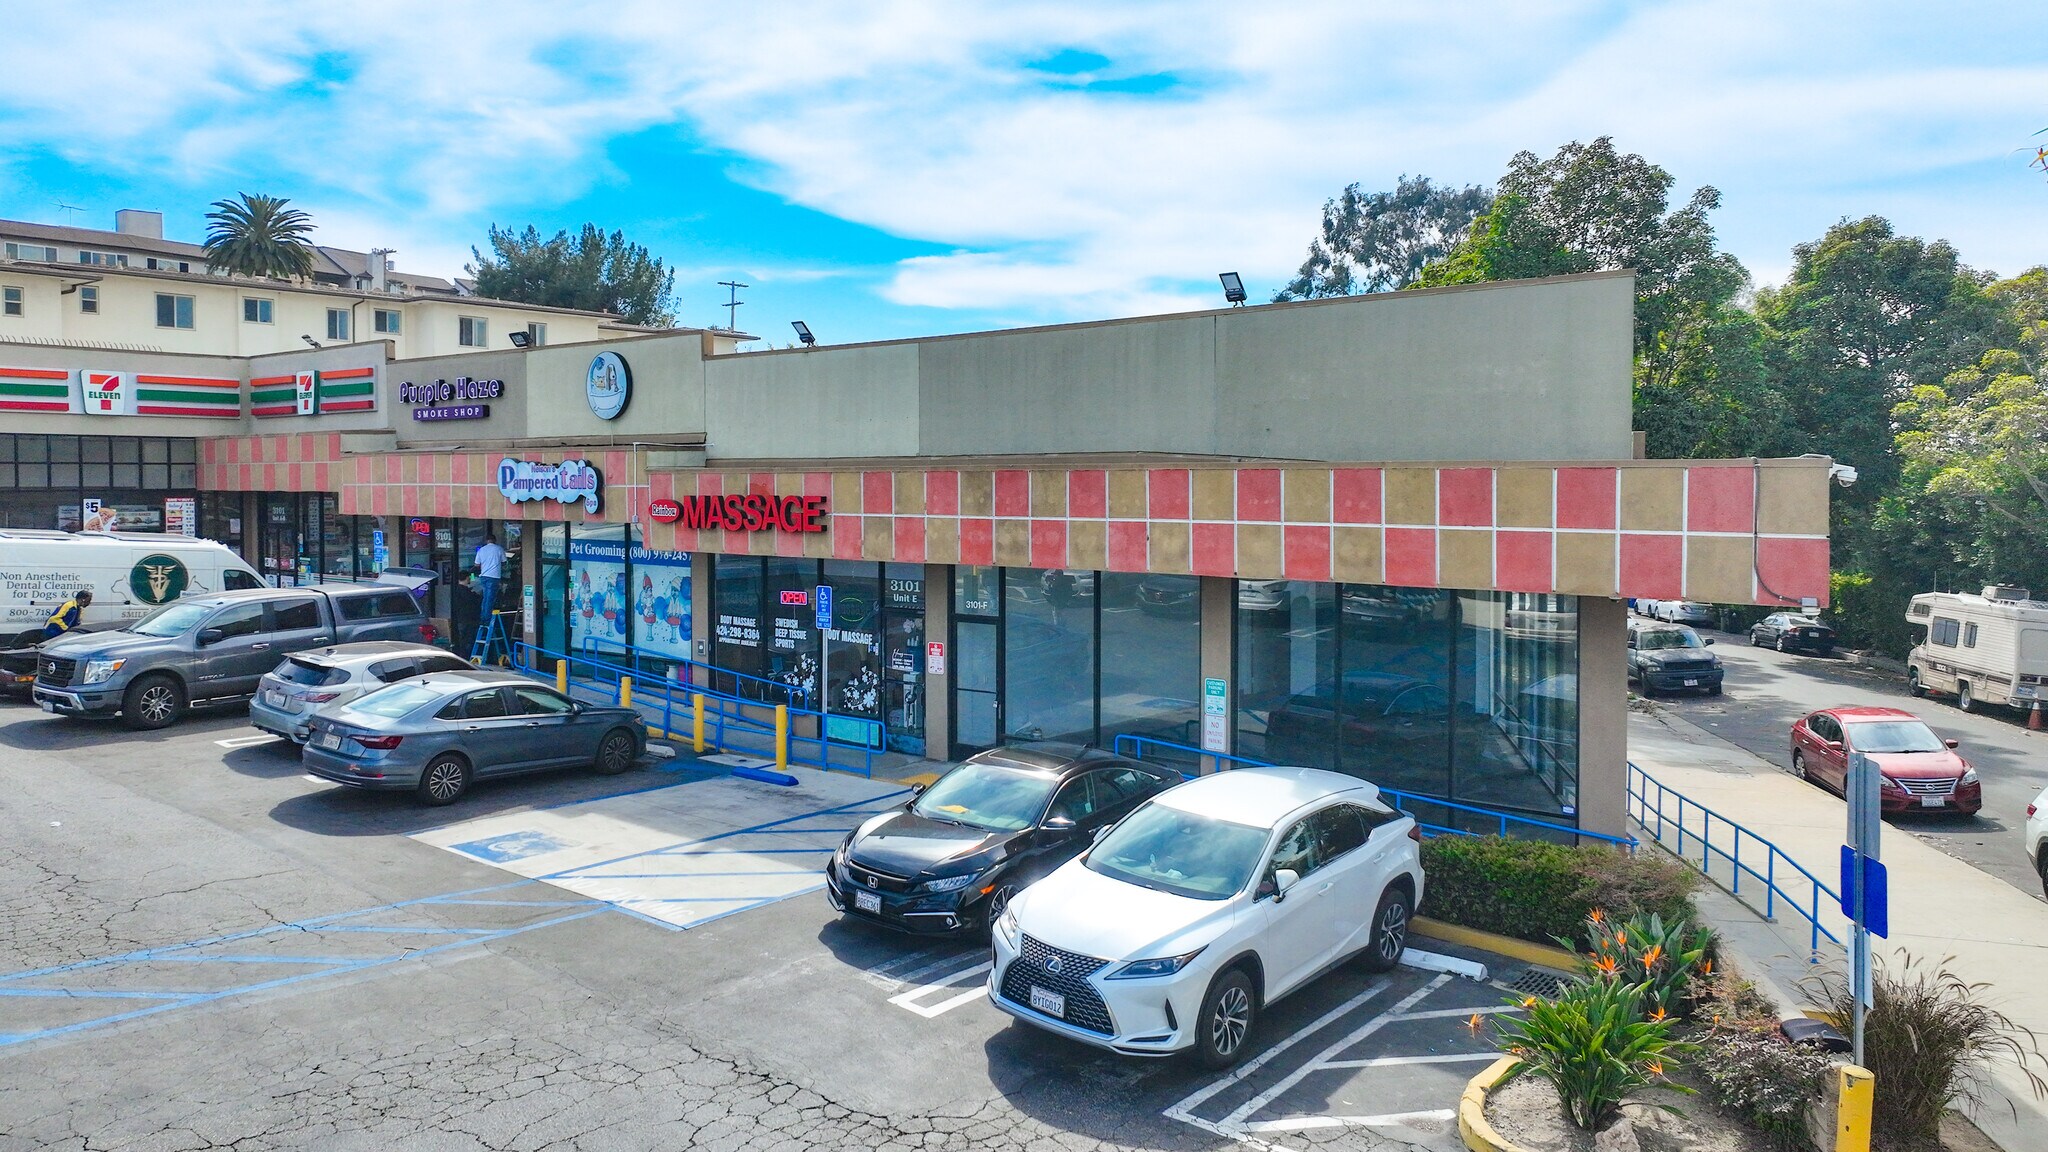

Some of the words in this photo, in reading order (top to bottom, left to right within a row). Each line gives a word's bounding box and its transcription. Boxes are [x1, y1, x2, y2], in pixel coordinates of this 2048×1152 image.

[90, 374, 119, 410] 7
[398, 379, 451, 407] Purple
[456, 377, 500, 400] Haze
[417, 409, 448, 419] SMOKE
[454, 407, 480, 417] SHOP
[501, 465, 559, 492] Pampered
[560, 466, 595, 490] tails
[85, 501, 99, 513] $5
[586, 498, 597, 508] Spa
[651, 503, 677, 517] Rainbow
[683, 494, 823, 533] MASSAGE
[435, 532, 452, 541] 3101
[570, 543, 583, 554] Pet
[584, 543, 626, 560] Grooming
[629, 545, 651, 560] (800)
[1, 572, 22, 581] Non
[25, 572, 81, 581] Anesthetic
[6, 581, 41, 590] Dental
[44, 581, 95, 592] Cleanings
[890, 579, 921, 593] 3101
[13, 590, 28, 599] for
[32, 590, 57, 600] Dogs
[61, 590, 69, 598] &
[781, 592, 806, 603] OPEN
[893, 593, 910, 603] Unit
[912, 595, 918, 603] E
[966, 600, 988, 610] 3101-F
[720, 614, 733, 624] BODY
[733, 616, 757, 627] MASSAGE
[775, 617, 799, 629] SWEDISH
[716, 625, 760, 640] 424-298-8364
[775, 627, 788, 638] DEEP
[789, 629, 807, 640] TISSUE
[827, 629, 840, 641] ODY
[841, 630, 873, 645] MASSAGE
[775, 637, 795, 649] SPORTS
